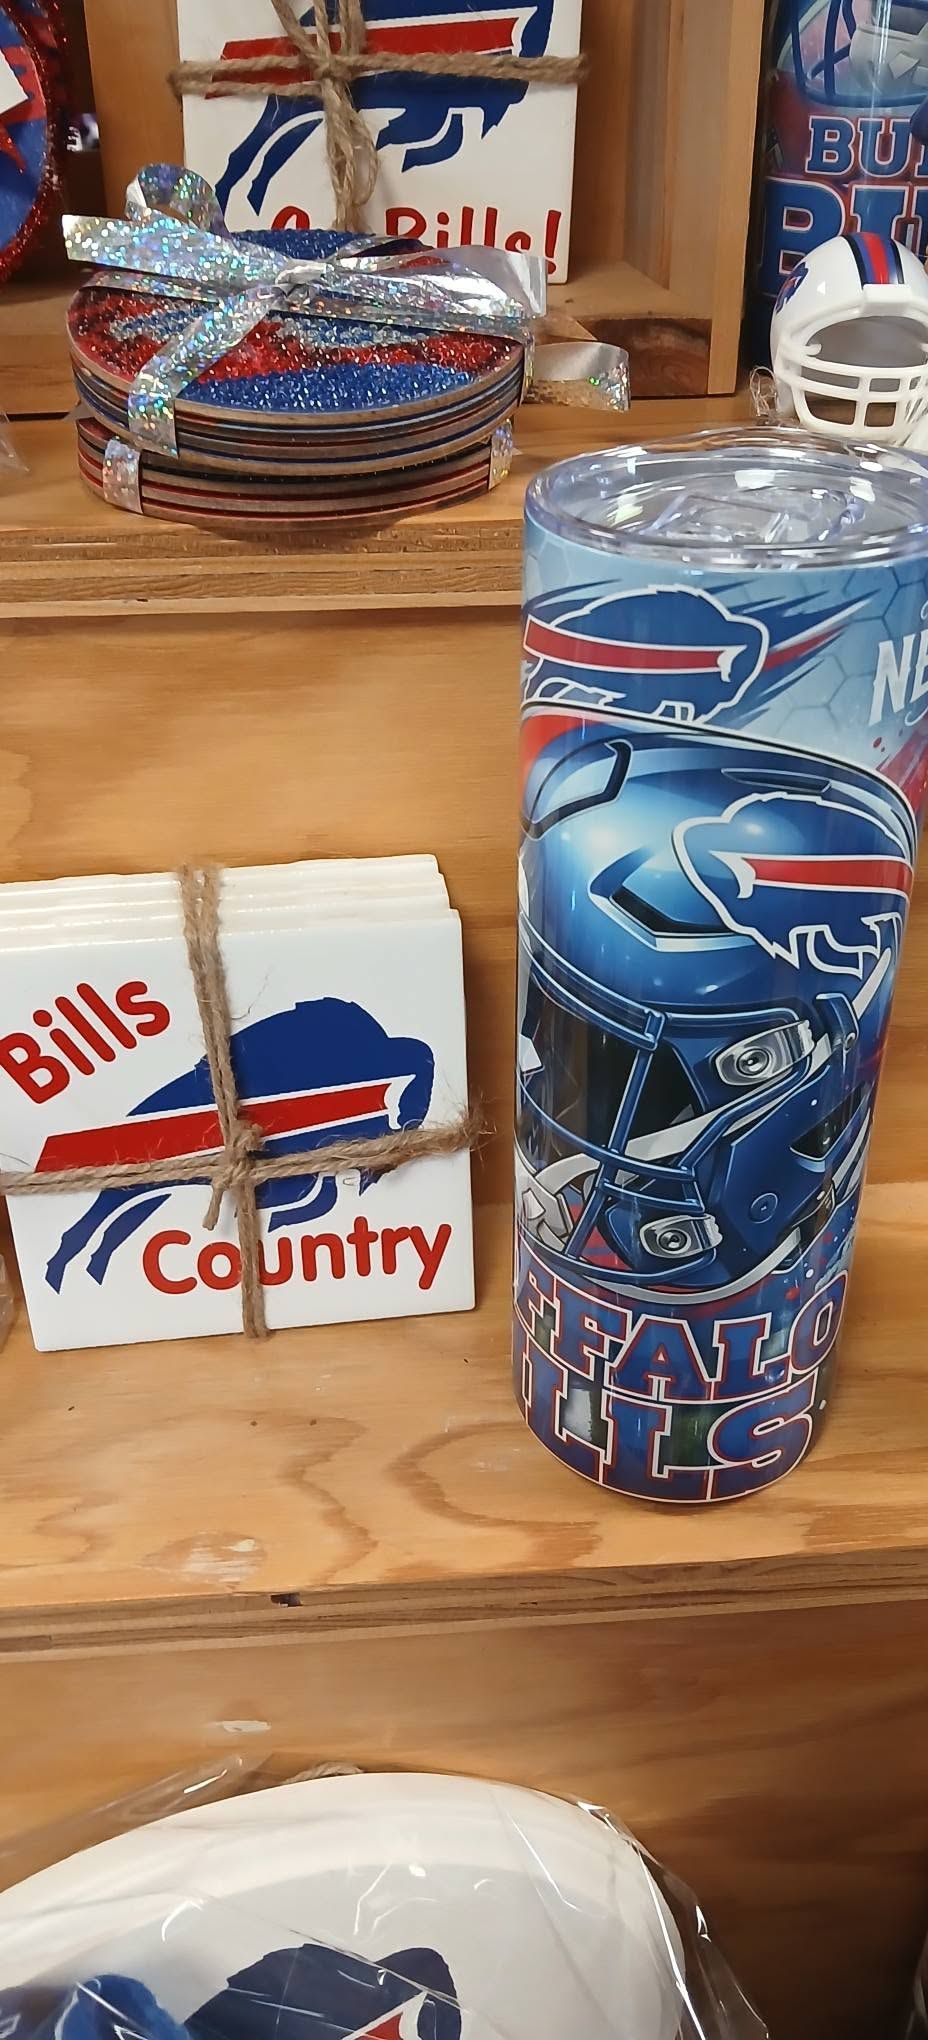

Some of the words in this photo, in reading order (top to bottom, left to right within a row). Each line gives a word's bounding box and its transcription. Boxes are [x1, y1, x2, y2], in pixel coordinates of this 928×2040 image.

[805, 115, 928, 178] BU
[0, 980, 171, 1104] Bills
[142, 1216, 452, 1294] Country
